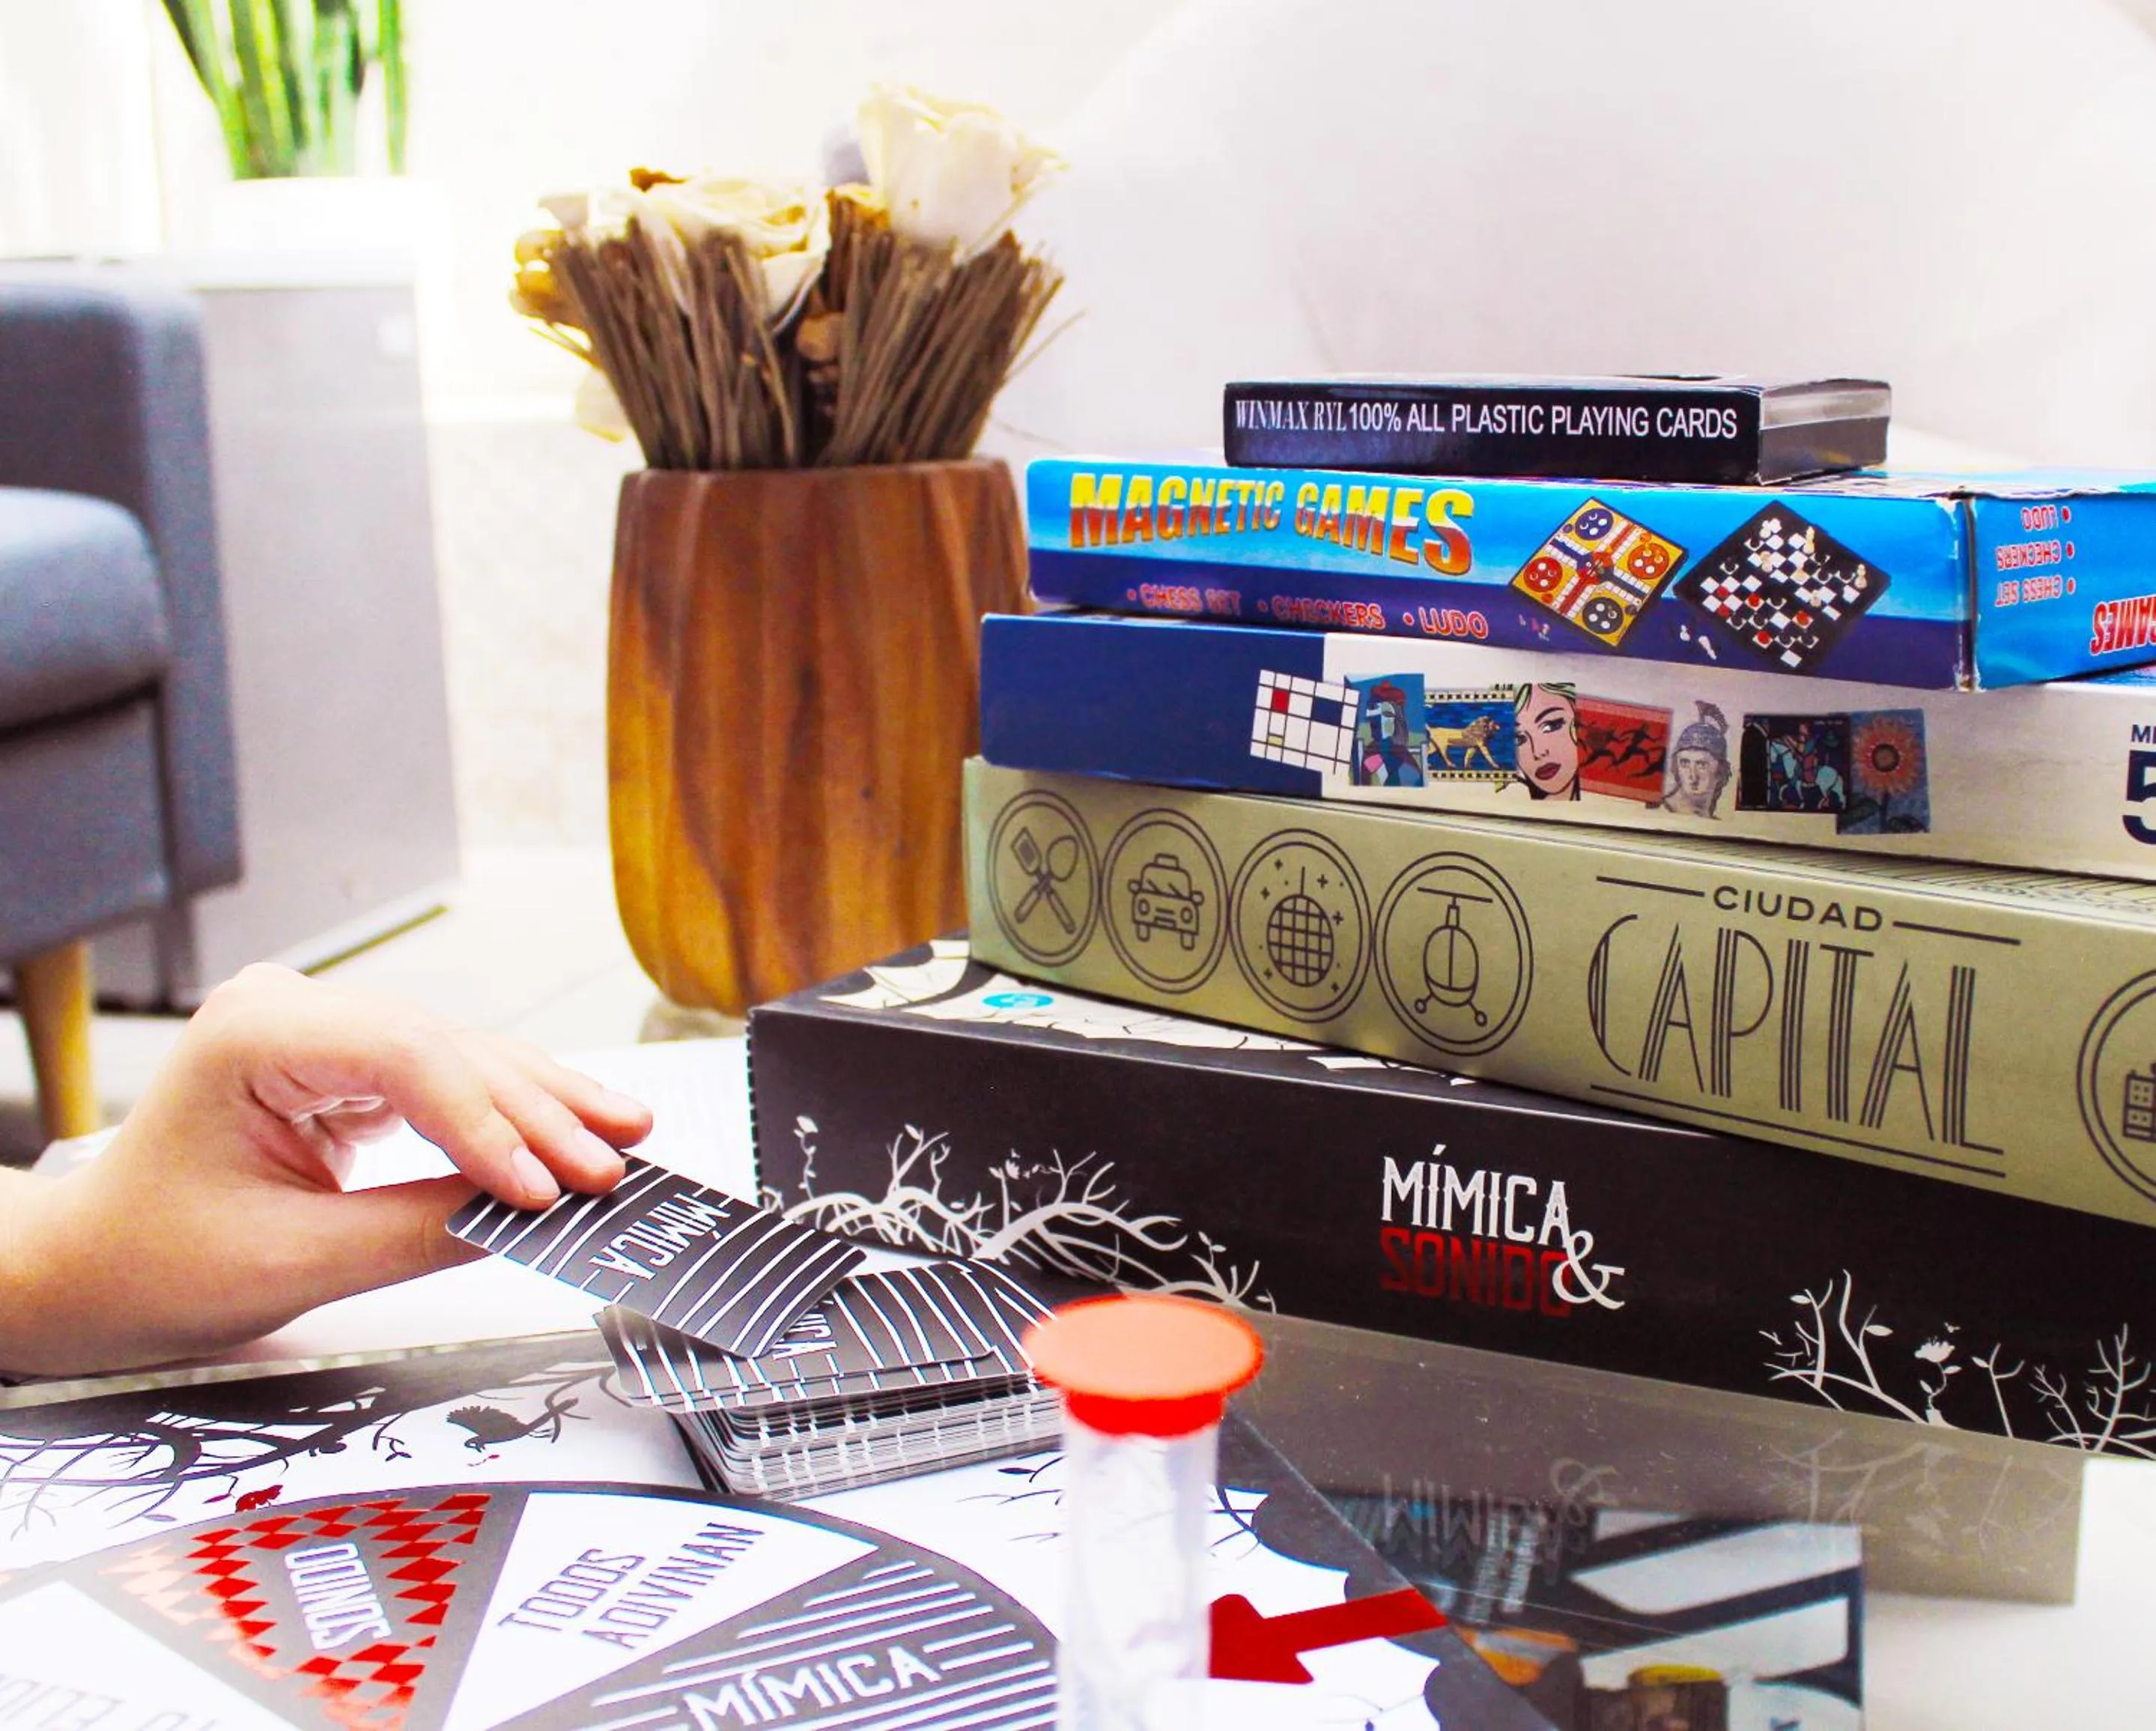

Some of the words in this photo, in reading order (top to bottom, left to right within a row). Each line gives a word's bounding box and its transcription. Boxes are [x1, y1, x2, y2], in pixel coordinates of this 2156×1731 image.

[1236, 400, 1309, 430] WINMAX
[1314, 401, 1346, 432] RYL
[1349, 402, 1401, 434] 100%
[1406, 405, 1445, 434] ALL
[1452, 404, 1544, 436] PLASTIC
[1552, 406, 1649, 438] PLAYING
[1656, 407, 1737, 439] CARDS
[1068, 472, 1284, 549] MAGNETIC
[1294, 482, 1475, 577] GAMES
[1995, 539, 2062, 571] CHECKERS
[2020, 504, 2058, 532] LUDO
[1272, 595, 1386, 630] CHECKERS
[1419, 606, 1490, 640] LUDO
[2023, 575, 2062, 603] CHESS
[1713, 885, 1883, 933] CIUDAD
[1587, 913, 2005, 1156] CAPITAL
[588, 1192, 732, 1281] MÍMICA
[1380, 1143, 1569, 1249] MÍMICA
[1379, 1226, 1573, 1319] SONIDO
[284, 1541, 392, 1651] SONIDO
[497, 1547, 646, 1631] TODOS
[582, 1522, 765, 1649] ADIVINAN
[682, 1646, 942, 1731] MÍMICA
